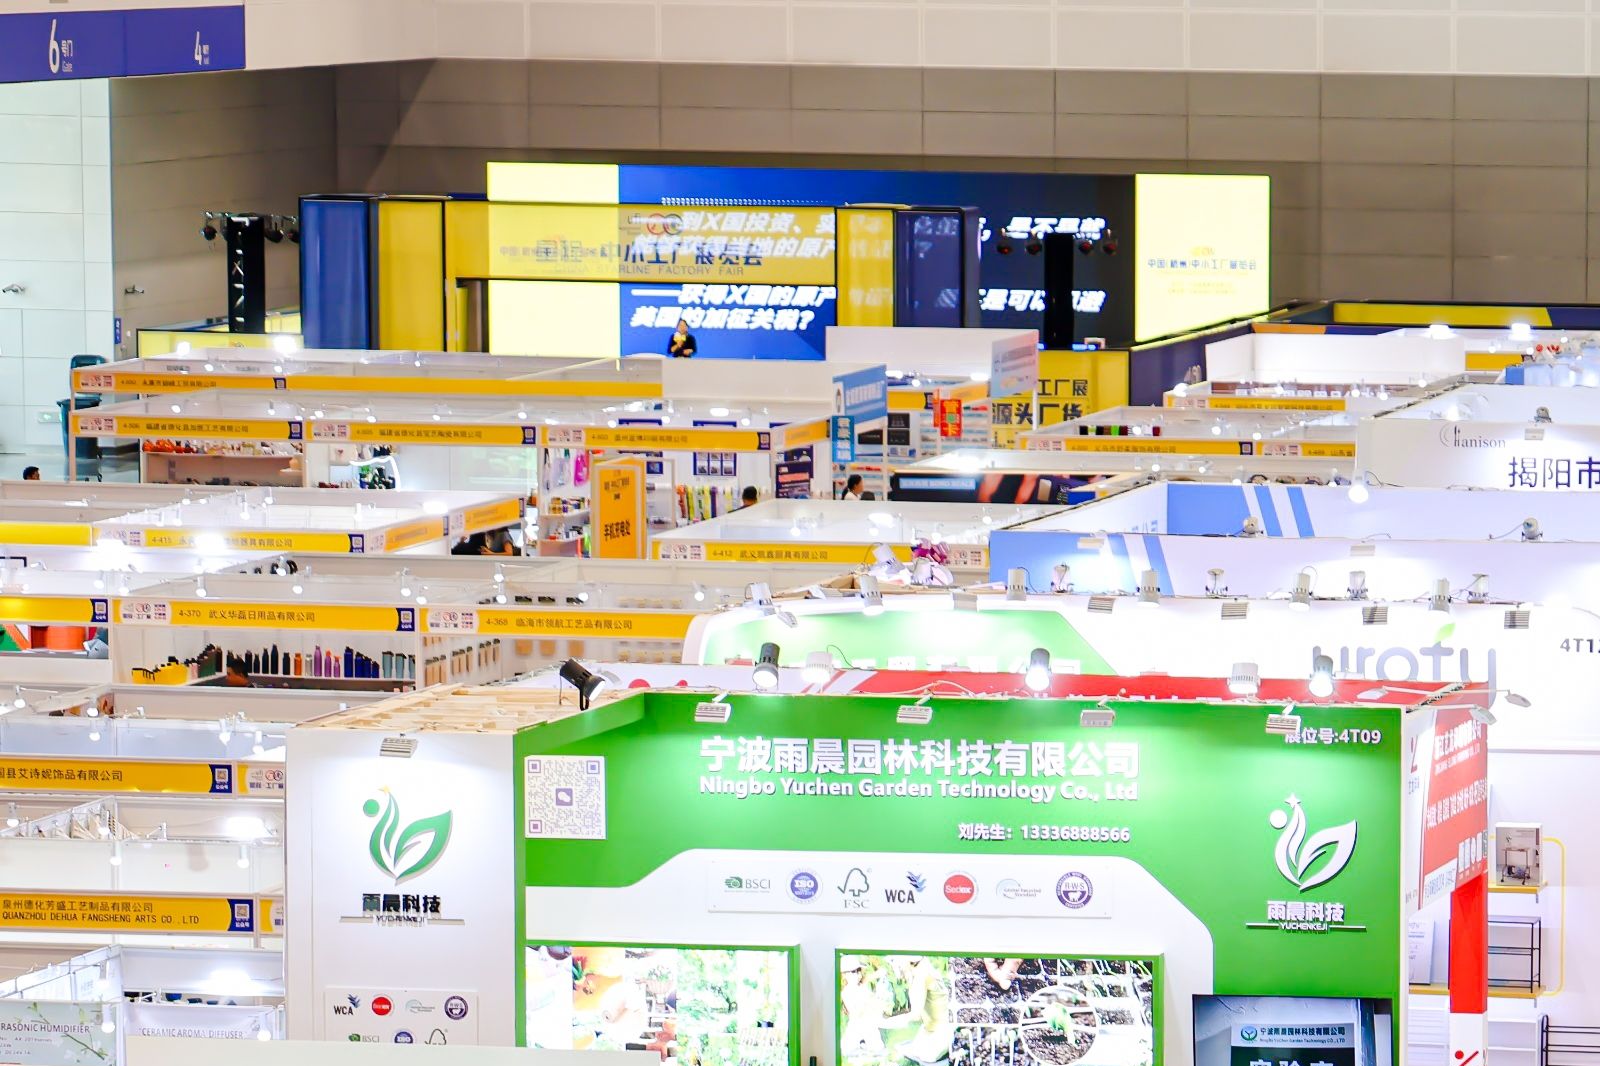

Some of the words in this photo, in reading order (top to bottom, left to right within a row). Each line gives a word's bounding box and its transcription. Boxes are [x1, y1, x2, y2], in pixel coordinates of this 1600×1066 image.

[49, 19, 60, 73] 6
[194, 31, 202, 65] 4
[659, 265, 711, 276] FACTORY
[719, 266, 745, 276] FAIR
[700, 737, 1139, 779] 宁波雨晨园林科技有限公司
[700, 777, 776, 799] Ningbo
[780, 778, 854, 796] Yuchen
[858, 778, 933, 798] Garden
[938, 780, 1056, 803] Technology
[1061, 781, 1100, 803] Co.,
[1105, 781, 1138, 801] Ltd
[958, 823, 1013, 841] 刘先生：
[1020, 825, 1131, 843] 13336888566
[363, 893, 441, 914] 雨晨科技
[745, 879, 771, 889] BSCI
[844, 899, 870, 909] FSC
[885, 889, 915, 904] WCA
[2, 912, 48, 921] QUANZHOU
[50, 913, 78, 921] DEHUA
[81, 914, 131, 922] FANGSHENG
[135, 914, 157, 923] ARTS
[1267, 901, 1345, 924] 雨晨科技
[334, 1005, 354, 1016] WCA
